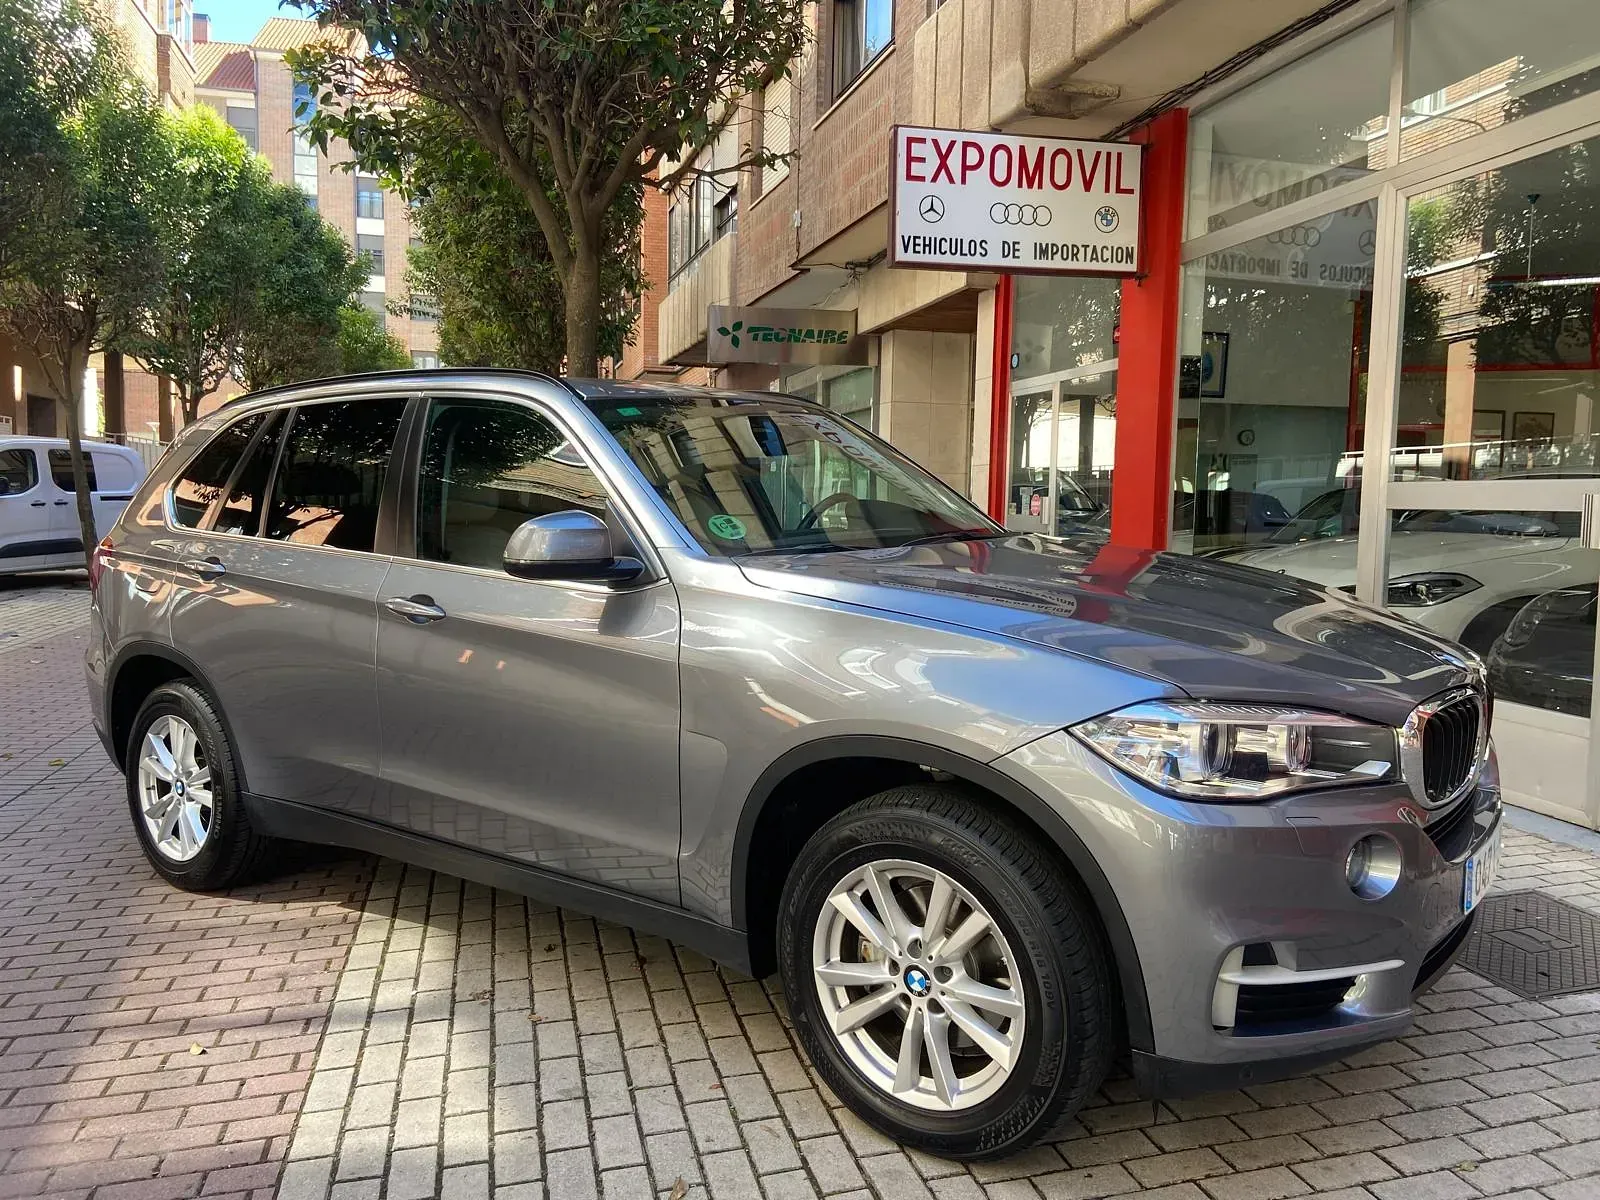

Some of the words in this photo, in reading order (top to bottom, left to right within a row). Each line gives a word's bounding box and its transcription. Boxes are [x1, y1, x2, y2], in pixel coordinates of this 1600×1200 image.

[905, 137, 1135, 194] EXPOMOVIL
[901, 234, 988, 257] VEHICULOS
[1001, 240, 1021, 260] DE
[1033, 241, 1135, 265] IMPORTACION
[746, 326, 849, 345] TECNAIRE
